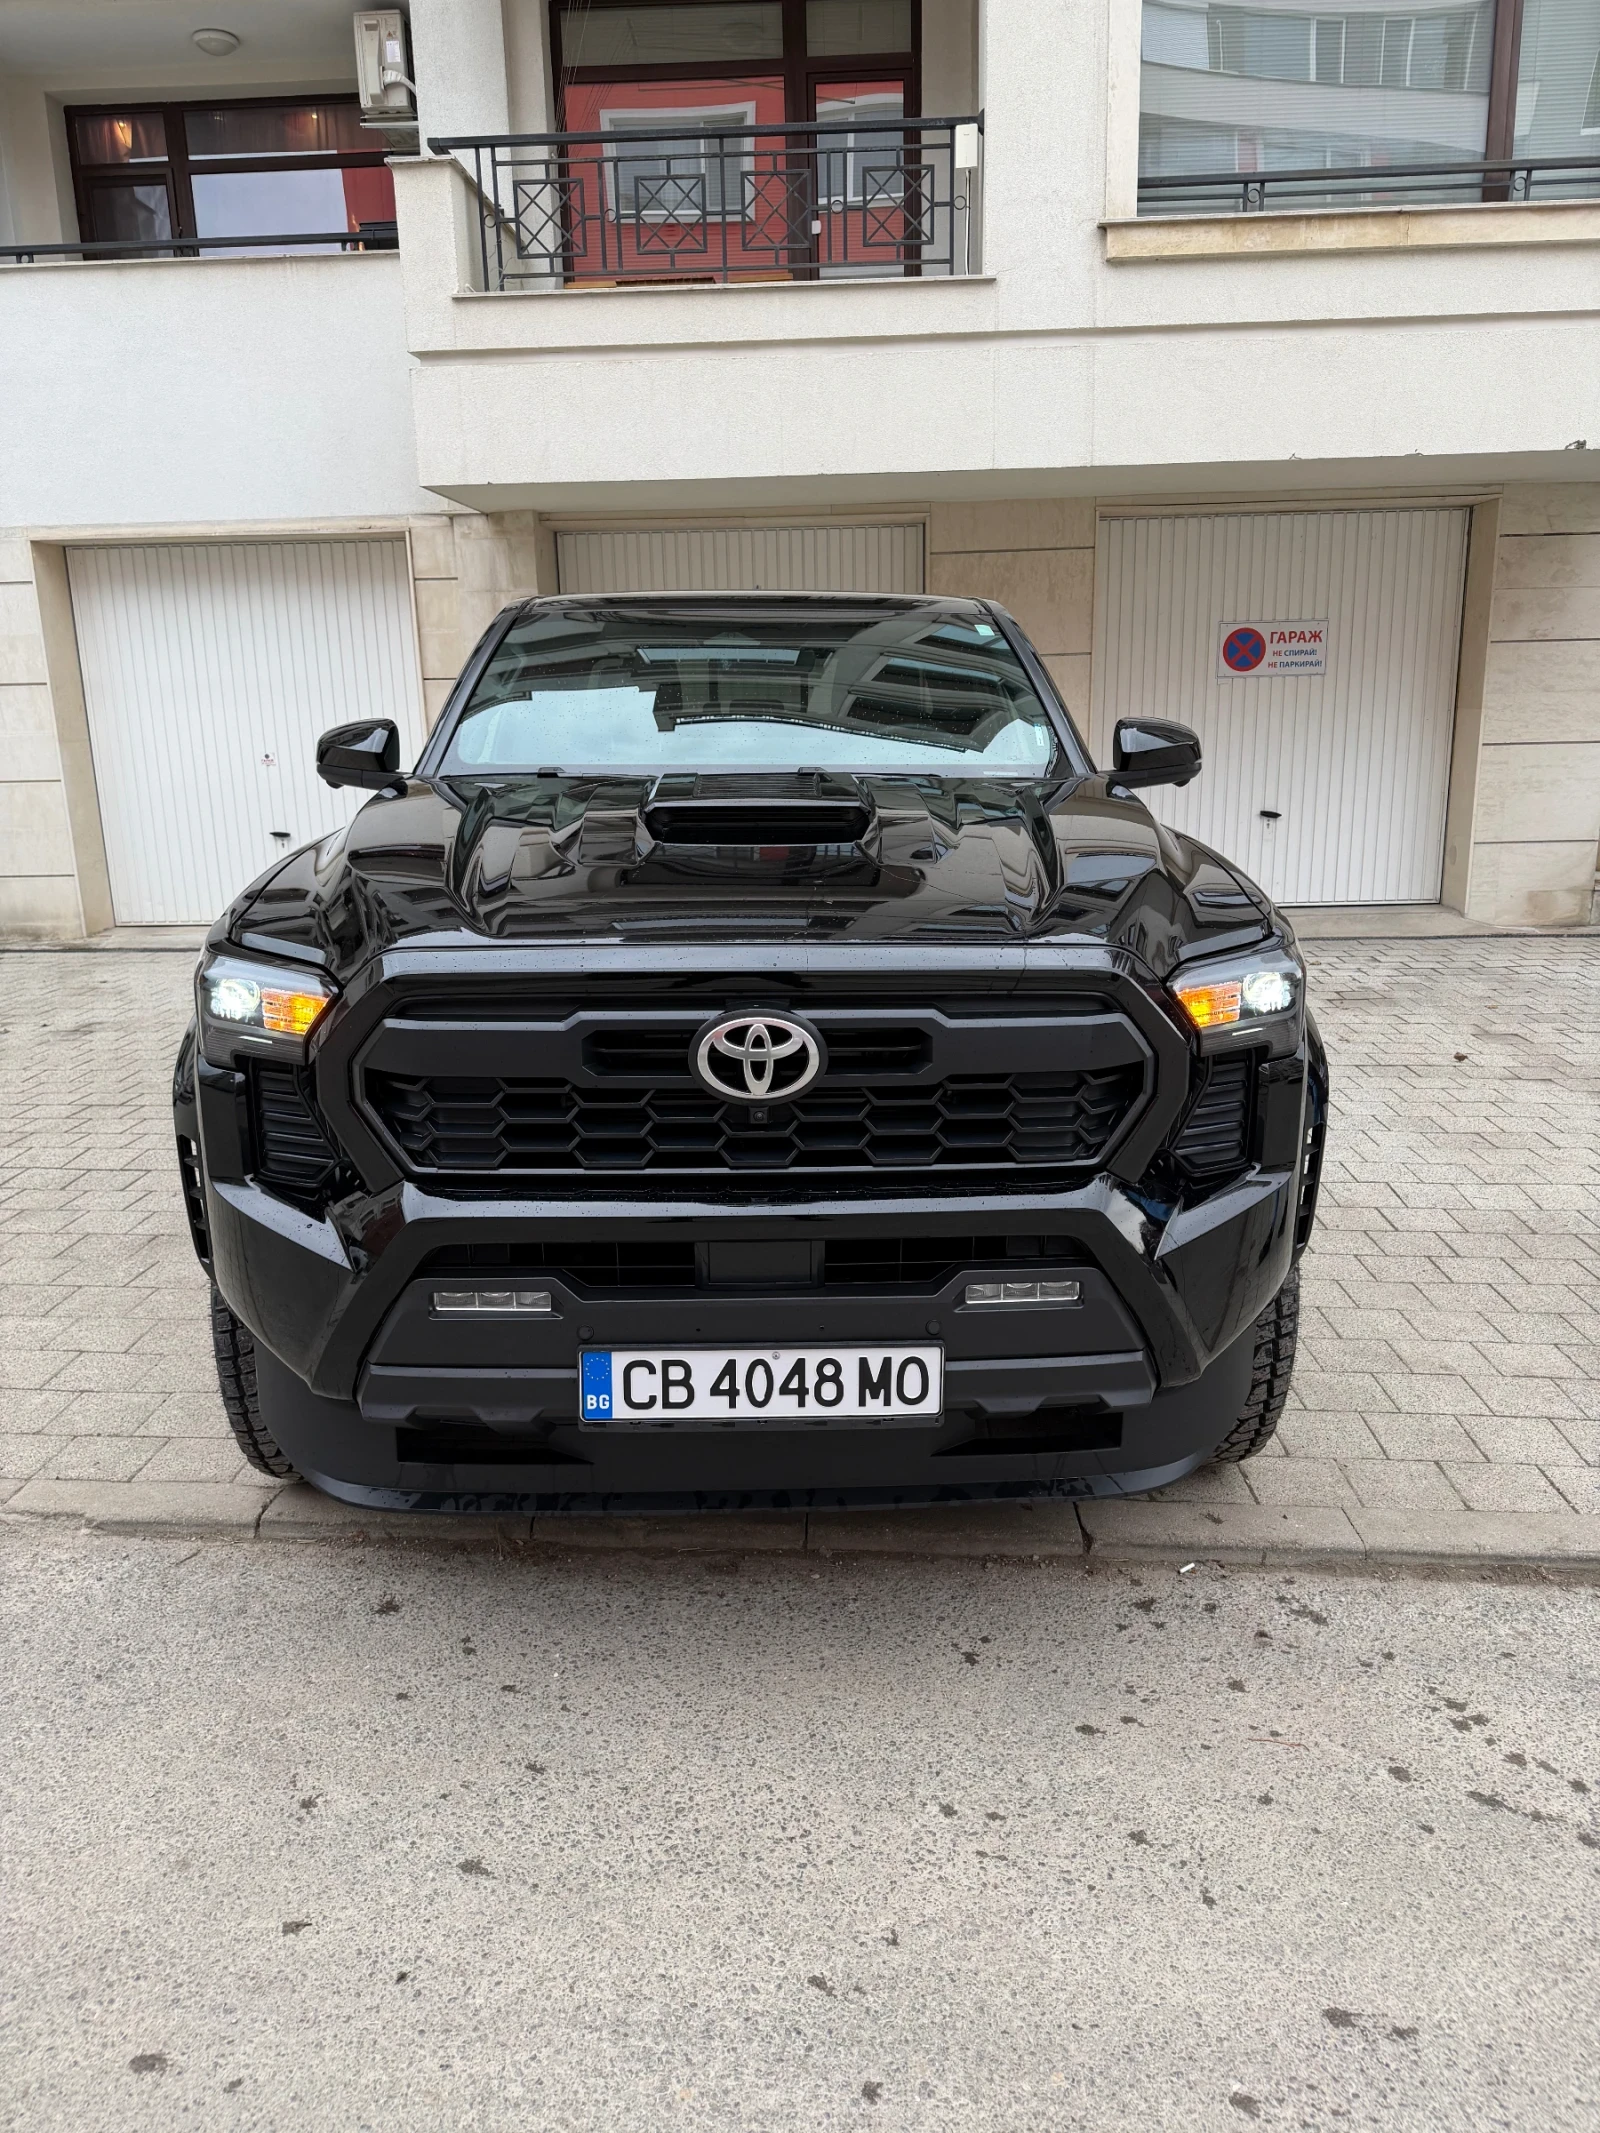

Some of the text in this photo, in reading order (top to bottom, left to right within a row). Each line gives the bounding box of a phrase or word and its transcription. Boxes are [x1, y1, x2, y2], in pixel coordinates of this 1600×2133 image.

[1270, 630, 1322, 644] ГАРАЖ
[1284, 648, 1318, 656] СПИРАЙ!
[1280, 659, 1322, 668] ПАРКИРАЙ!
[622, 1355, 930, 1410] CB 4048 MO
[586, 1394, 610, 1410] BG
